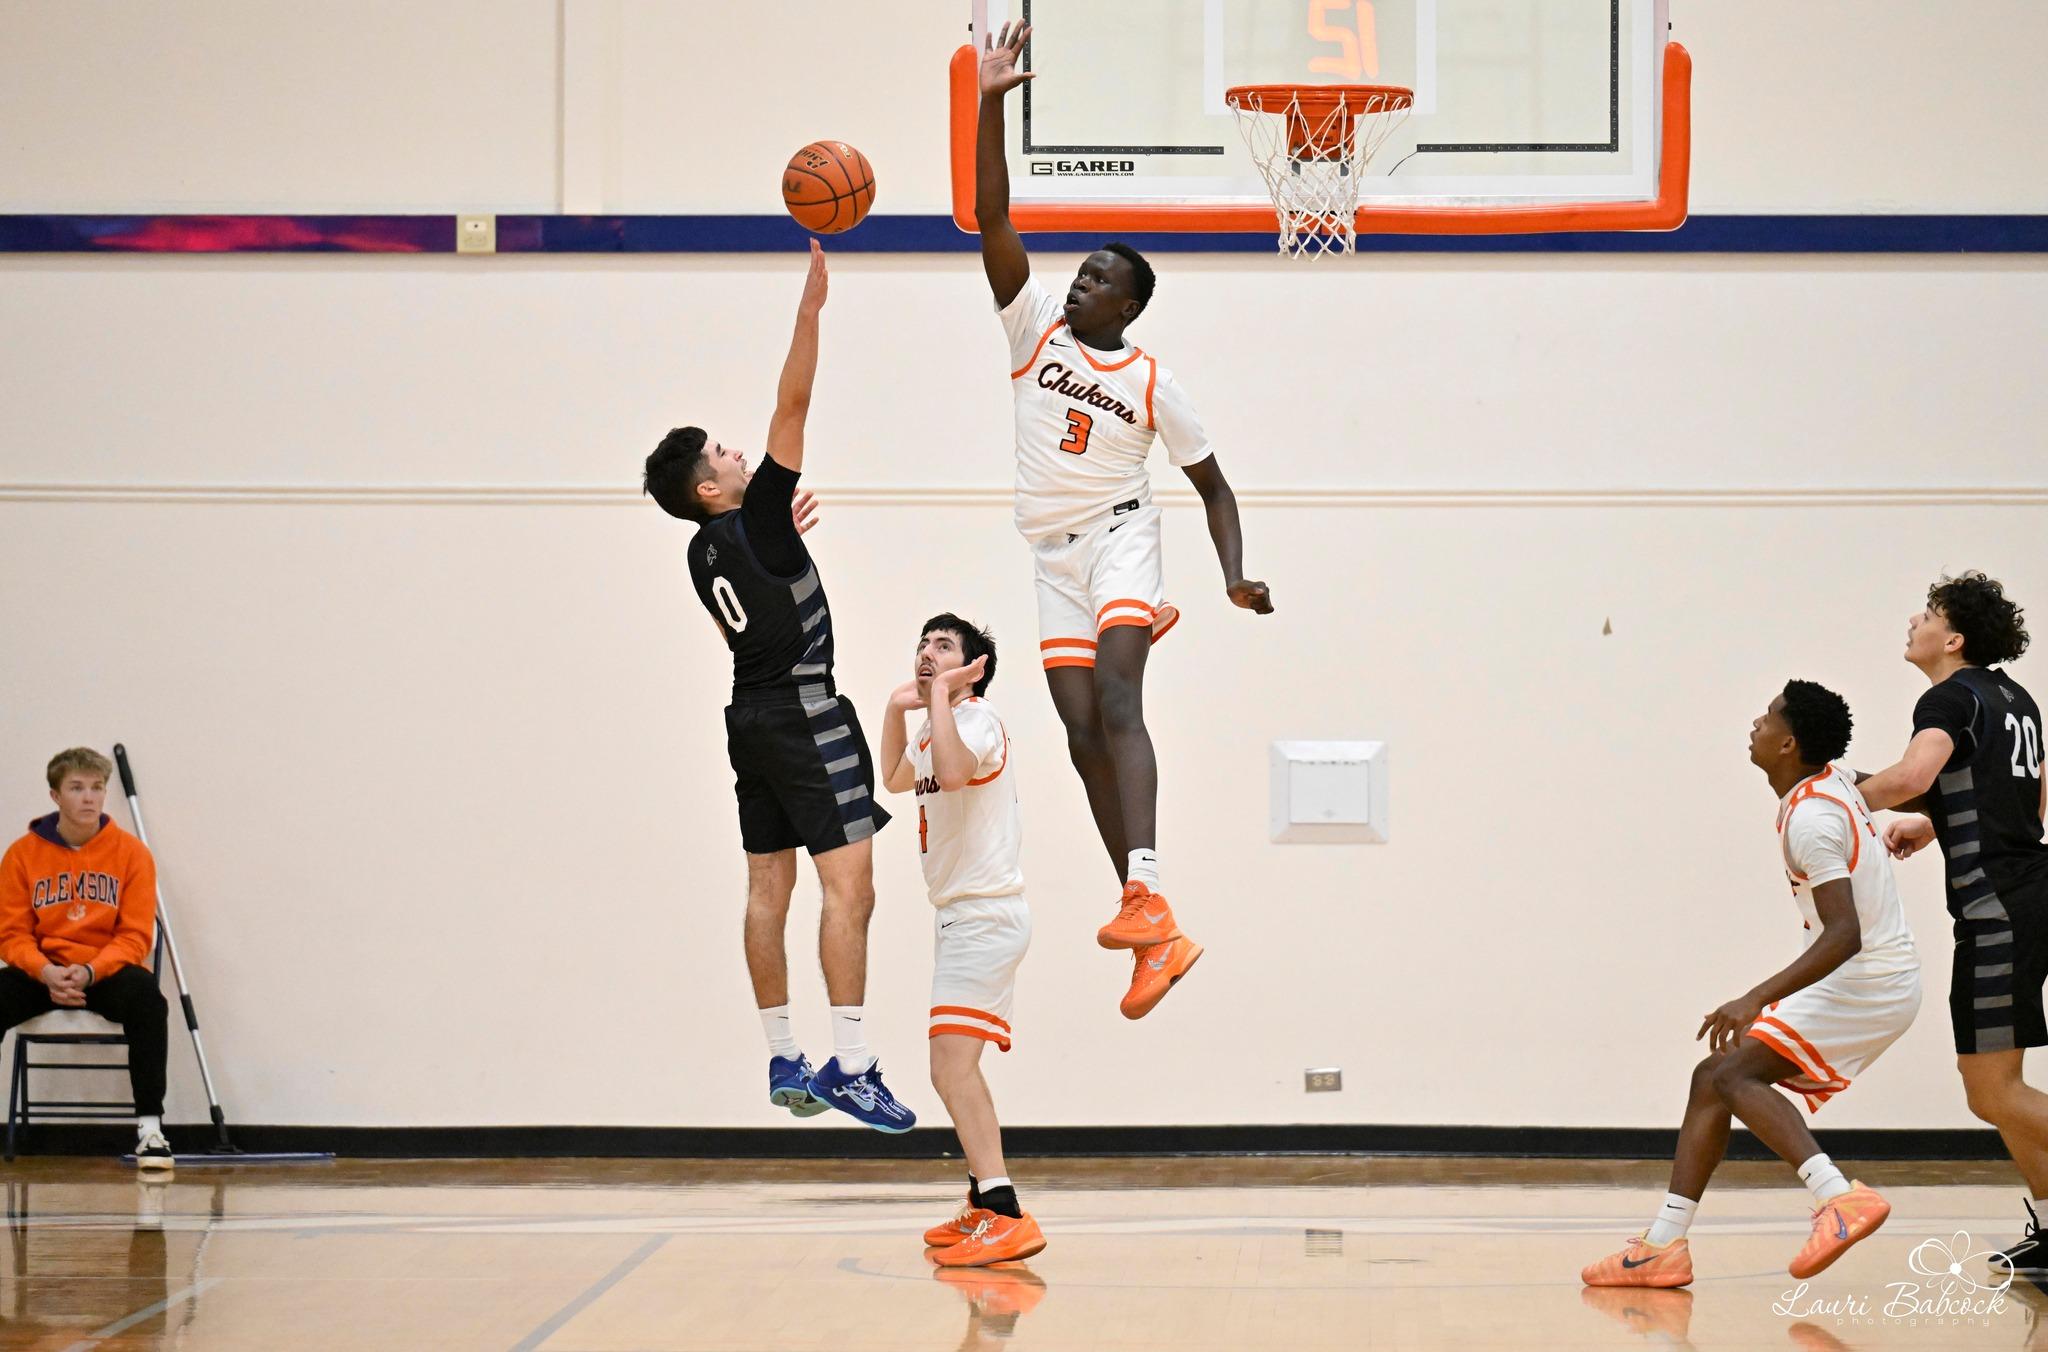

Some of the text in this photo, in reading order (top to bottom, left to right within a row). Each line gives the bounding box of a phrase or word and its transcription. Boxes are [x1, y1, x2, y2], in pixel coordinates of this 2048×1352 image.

[1057, 161, 1134, 172] GARED
[1038, 362, 1137, 425] Chukars
[1059, 408, 1094, 455] 3
[712, 576, 748, 633] 0
[2004, 712, 2041, 779] 20
[33, 871, 119, 909] CLEMSON
